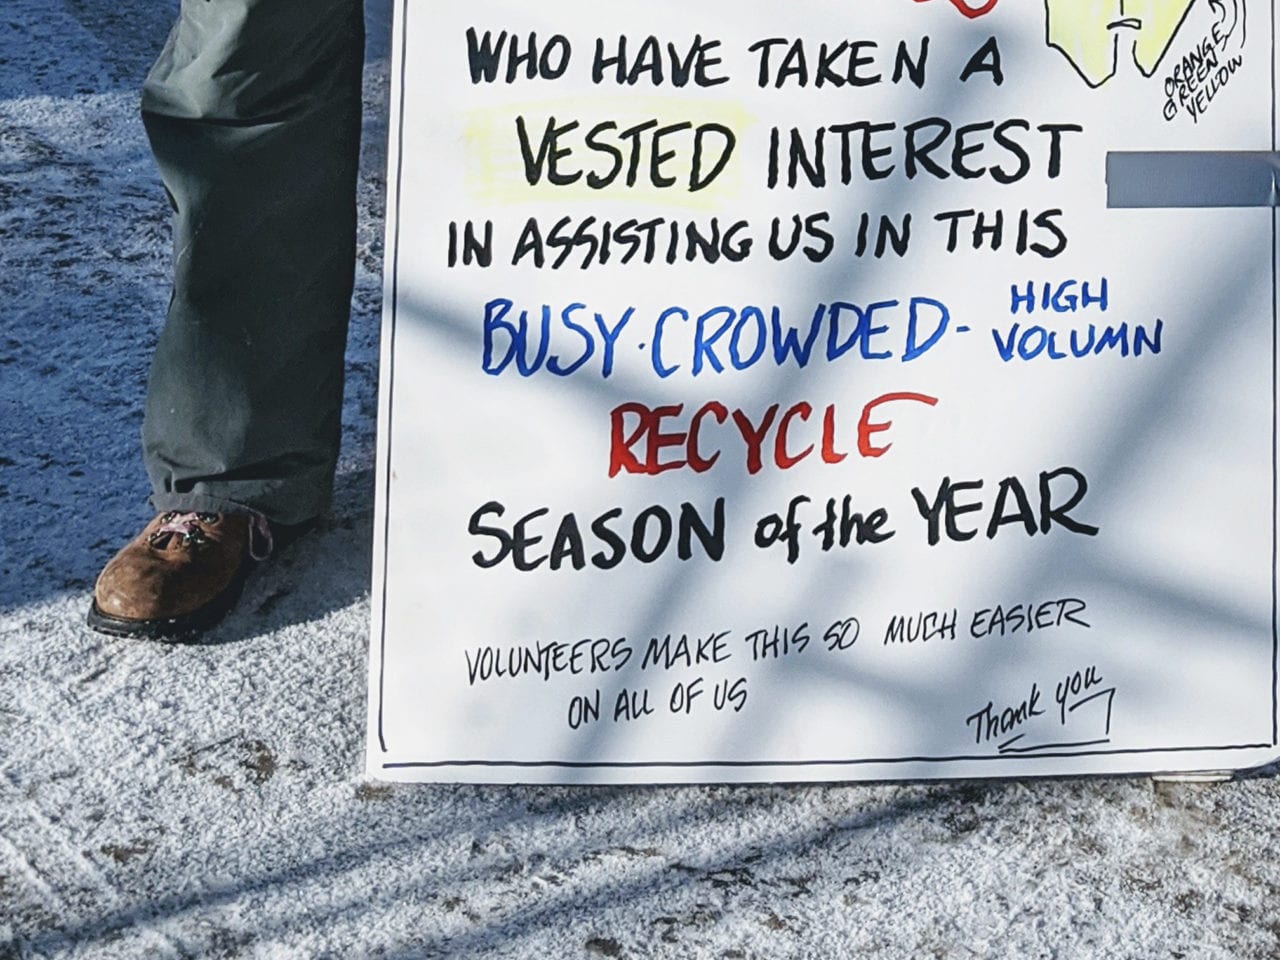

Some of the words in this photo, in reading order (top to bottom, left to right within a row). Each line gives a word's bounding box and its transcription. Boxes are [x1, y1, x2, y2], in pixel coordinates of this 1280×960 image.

[465, 26, 572, 85] WHO
[591, 34, 731, 89] HAVE
[747, 35, 930, 90] TAKEN
[958, 35, 1005, 87] A
[1163, 48, 1219, 121] GREEN
[1165, 21, 1226, 98] ORANGE
[1186, 55, 1243, 124] YELLOW
[515, 115, 738, 193] VESTED
[767, 120, 1084, 190] INTEREST
[447, 219, 493, 268] IN
[511, 213, 754, 271] ASSISTING
[768, 211, 835, 264] US
[854, 211, 912, 260] IN
[934, 208, 1068, 259] THIS
[1010, 277, 1109, 315] HIGH
[991, 318, 1164, 363] VOLUMN
[608, 391, 939, 479] RECYCLE
[467, 496, 726, 572] SEASON
[754, 493, 811, 565] of
[811, 494, 896, 552] the
[910, 466, 1100, 547] YEAR
[465, 637, 634, 686] VOLUNTEERS
[640, 630, 732, 671] MAKE
[745, 622, 811, 664] THIS
[822, 617, 860, 652] SO
[883, 609, 957, 646] MUCH
[970, 597, 1091, 639] EASIER
[567, 689, 601, 730] ON
[613, 684, 655, 722] ALL
[669, 678, 704, 715] OF
[713, 678, 748, 713] US
[966, 683, 1046, 745] Thank
[1055, 665, 1103, 726] you
